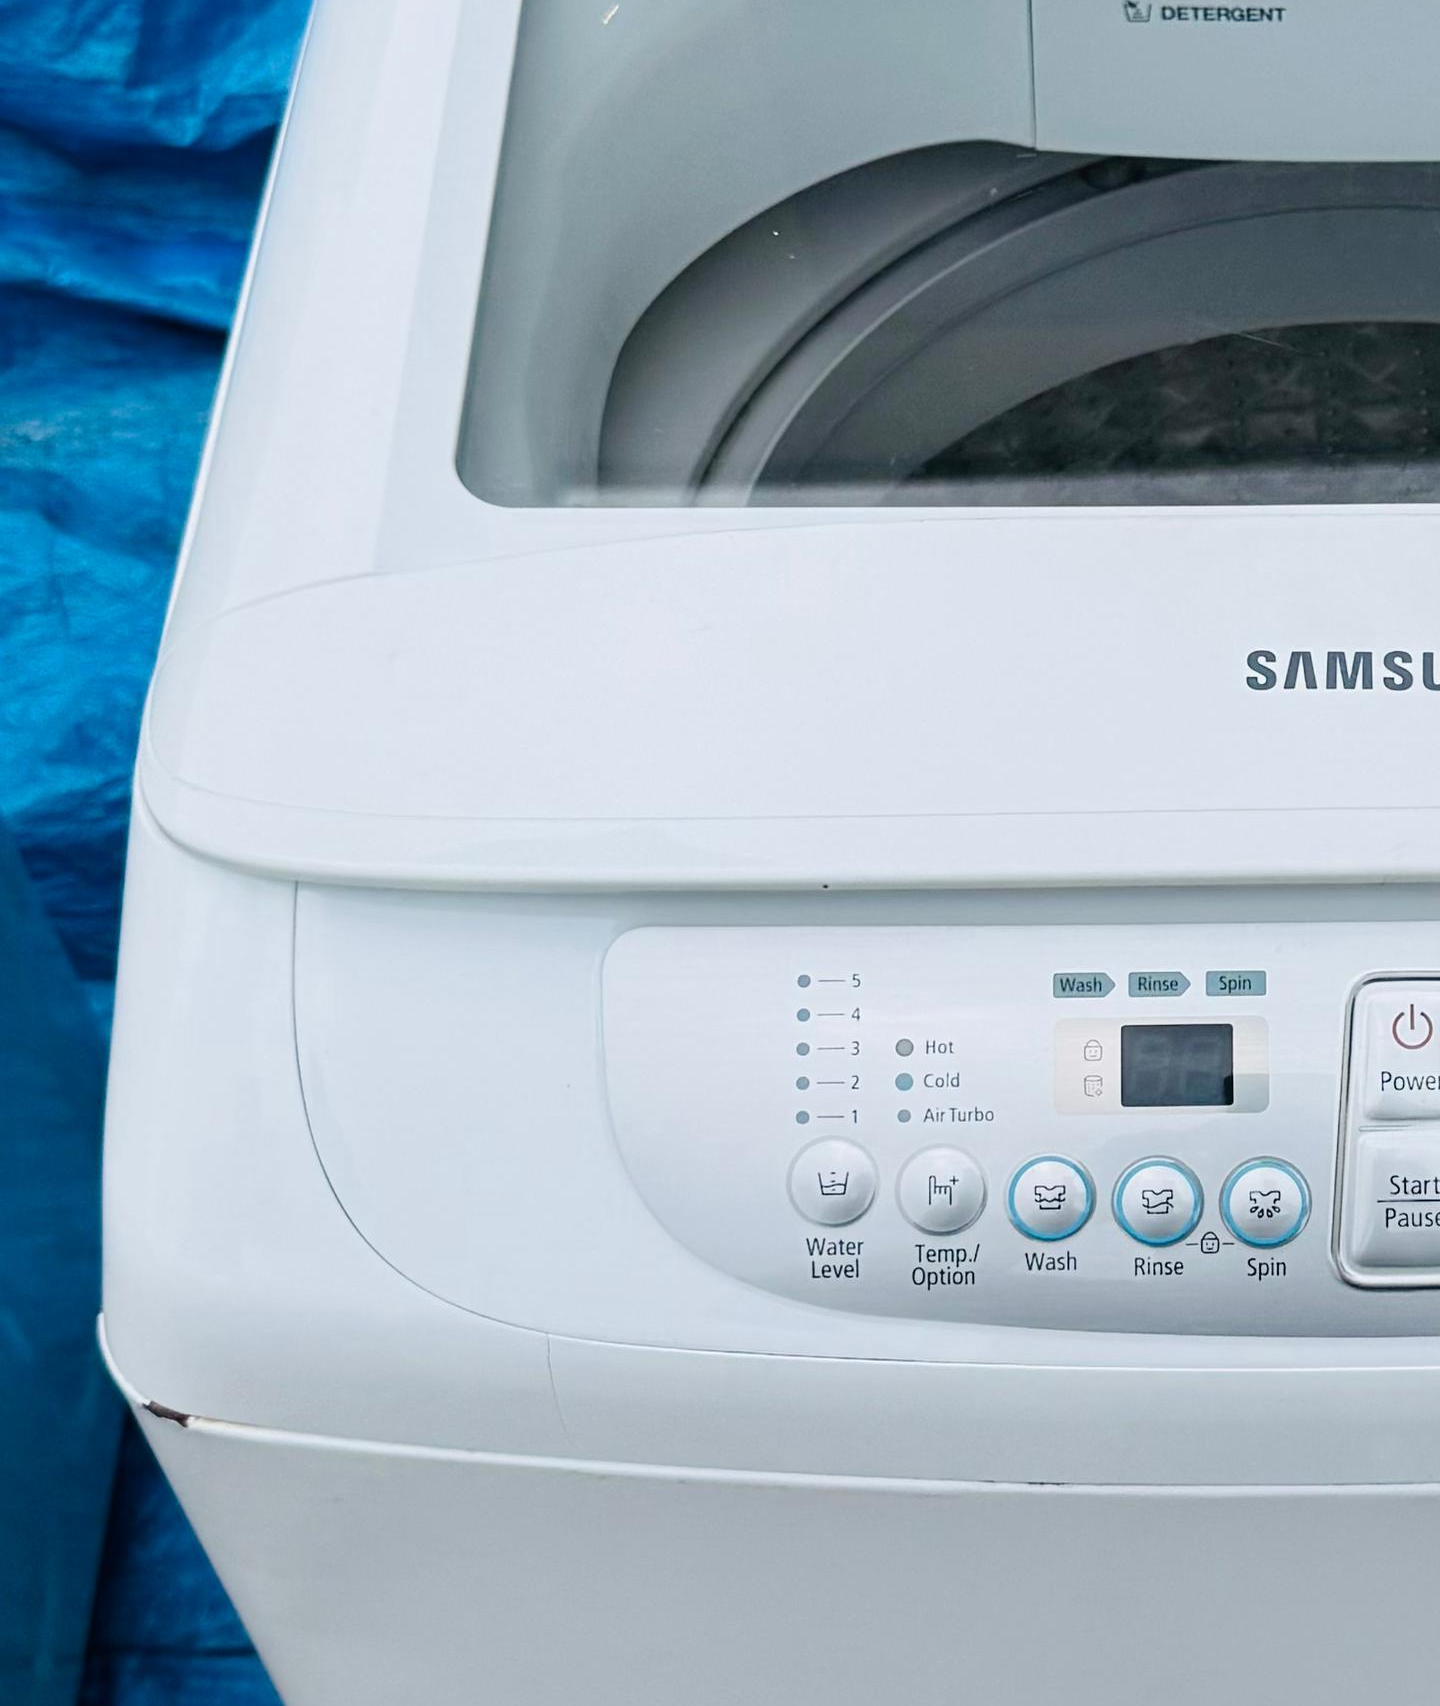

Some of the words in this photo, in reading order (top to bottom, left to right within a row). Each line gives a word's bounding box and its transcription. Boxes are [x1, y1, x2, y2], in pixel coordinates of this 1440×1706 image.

[1161, 5, 1286, 23] DETERGENT
[852, 973, 861, 988] 5
[1059, 976, 1103, 993] Wash
[1137, 976, 1179, 992] Rinse
[1219, 975, 1252, 994] Spin
[851, 1007, 861, 1022] 4
[851, 1040, 860, 1056] 3
[925, 1040, 954, 1055] Hot
[851, 1074, 860, 1090] 2
[923, 1072, 960, 1088] Cold
[852, 1109, 858, 1124] 1
[923, 1108, 946, 1123] Air
[949, 1106, 995, 1123] Turbo
[1389, 1174, 1440, 1196] Start
[805, 1237, 864, 1257] Water
[914, 1243, 980, 1267] Temp./
[811, 1259, 860, 1279] Level
[1024, 1250, 1077, 1271] Wash
[1134, 1257, 1184, 1277] Rinse
[1247, 1257, 1287, 1282] Spin
[911, 1267, 975, 1291] Option
